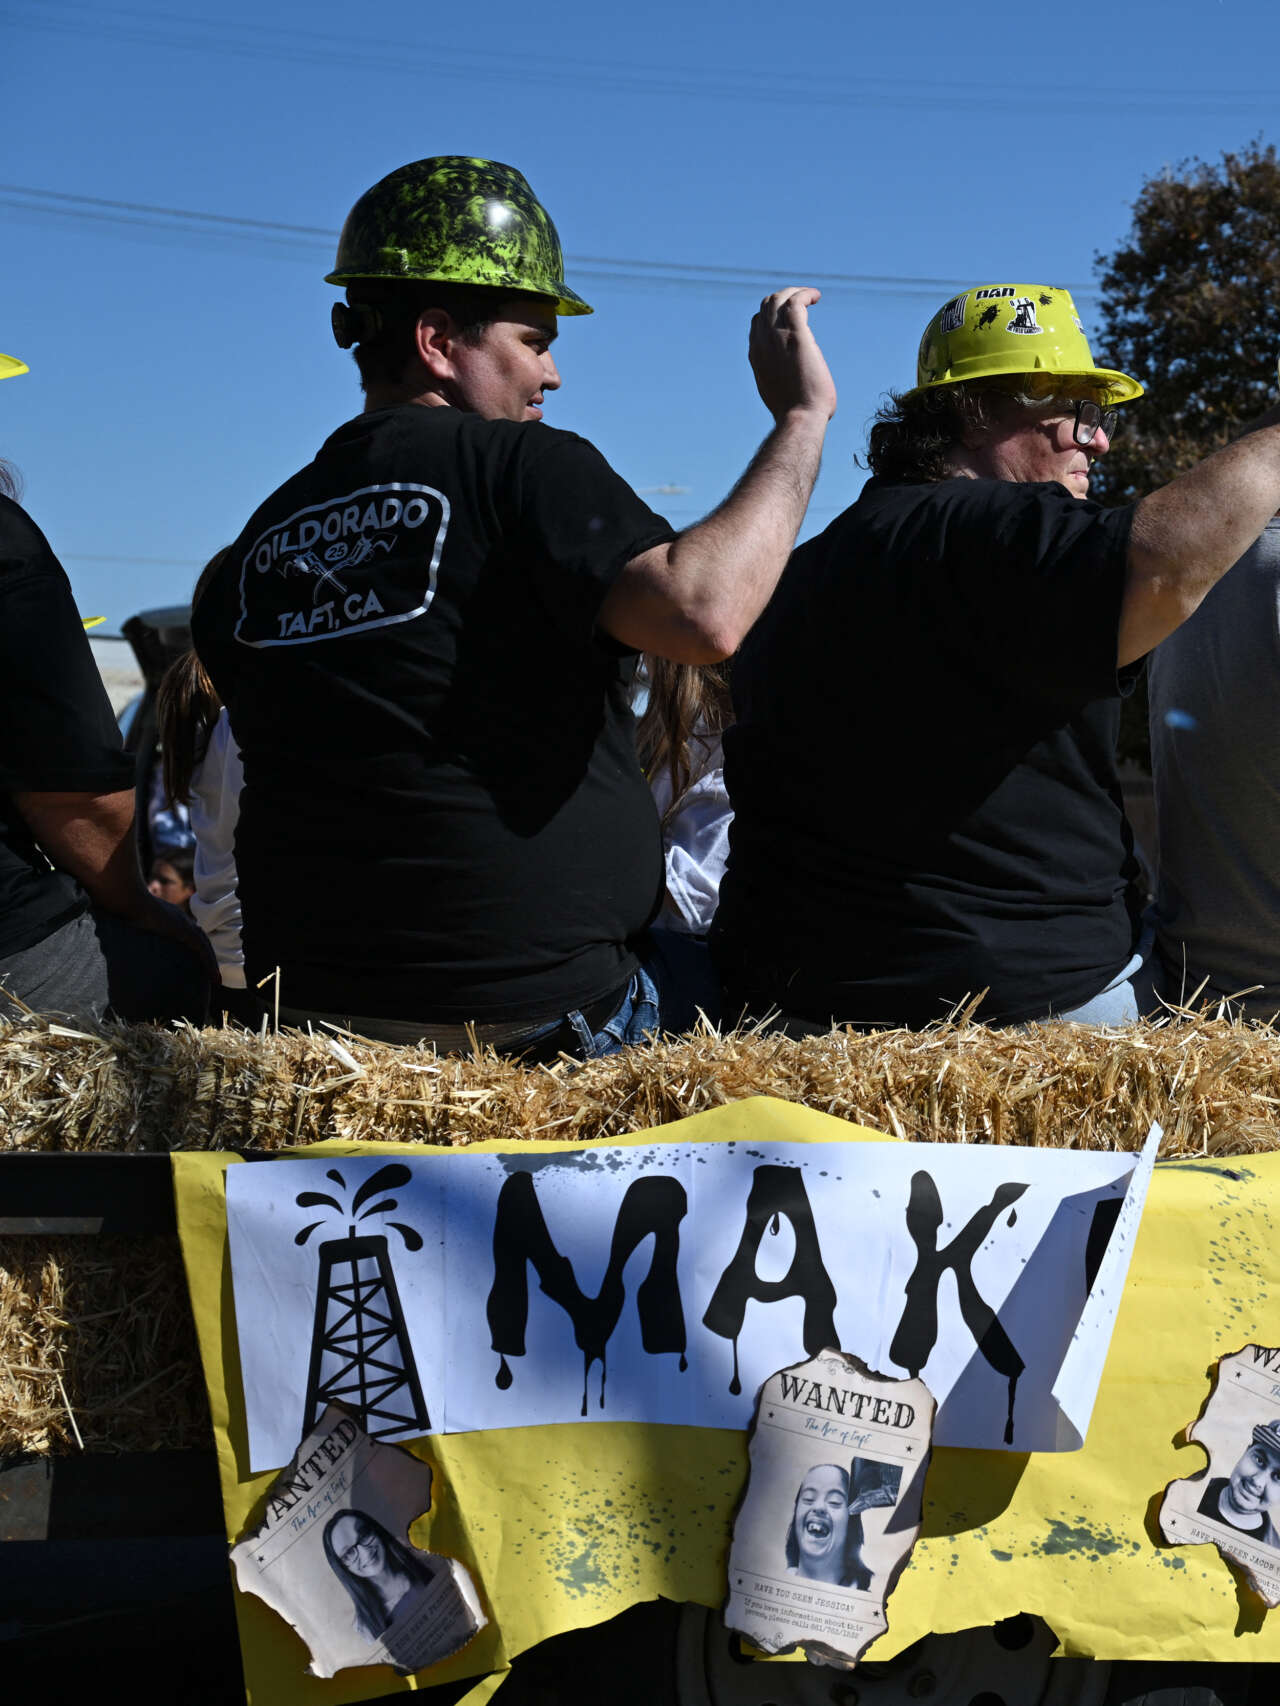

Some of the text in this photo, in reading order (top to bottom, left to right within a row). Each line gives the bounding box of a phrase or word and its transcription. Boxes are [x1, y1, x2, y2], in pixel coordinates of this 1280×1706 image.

[256, 498, 429, 573] OILDORADO
[277, 588, 385, 637] TAFT, CA
[487, 1163, 1124, 1442] MAK
[780, 1373, 916, 1430] WANTED
[804, 1416, 819, 1431] The
[840, 1429, 851, 1445] of
[255, 1419, 358, 1538] ANTED
[1249, 1554, 1275, 1570] JACOB
[753, 1582, 773, 1595] HAVE
[776, 1587, 790, 1599] YOU
[791, 1590, 813, 1604] SEEN
